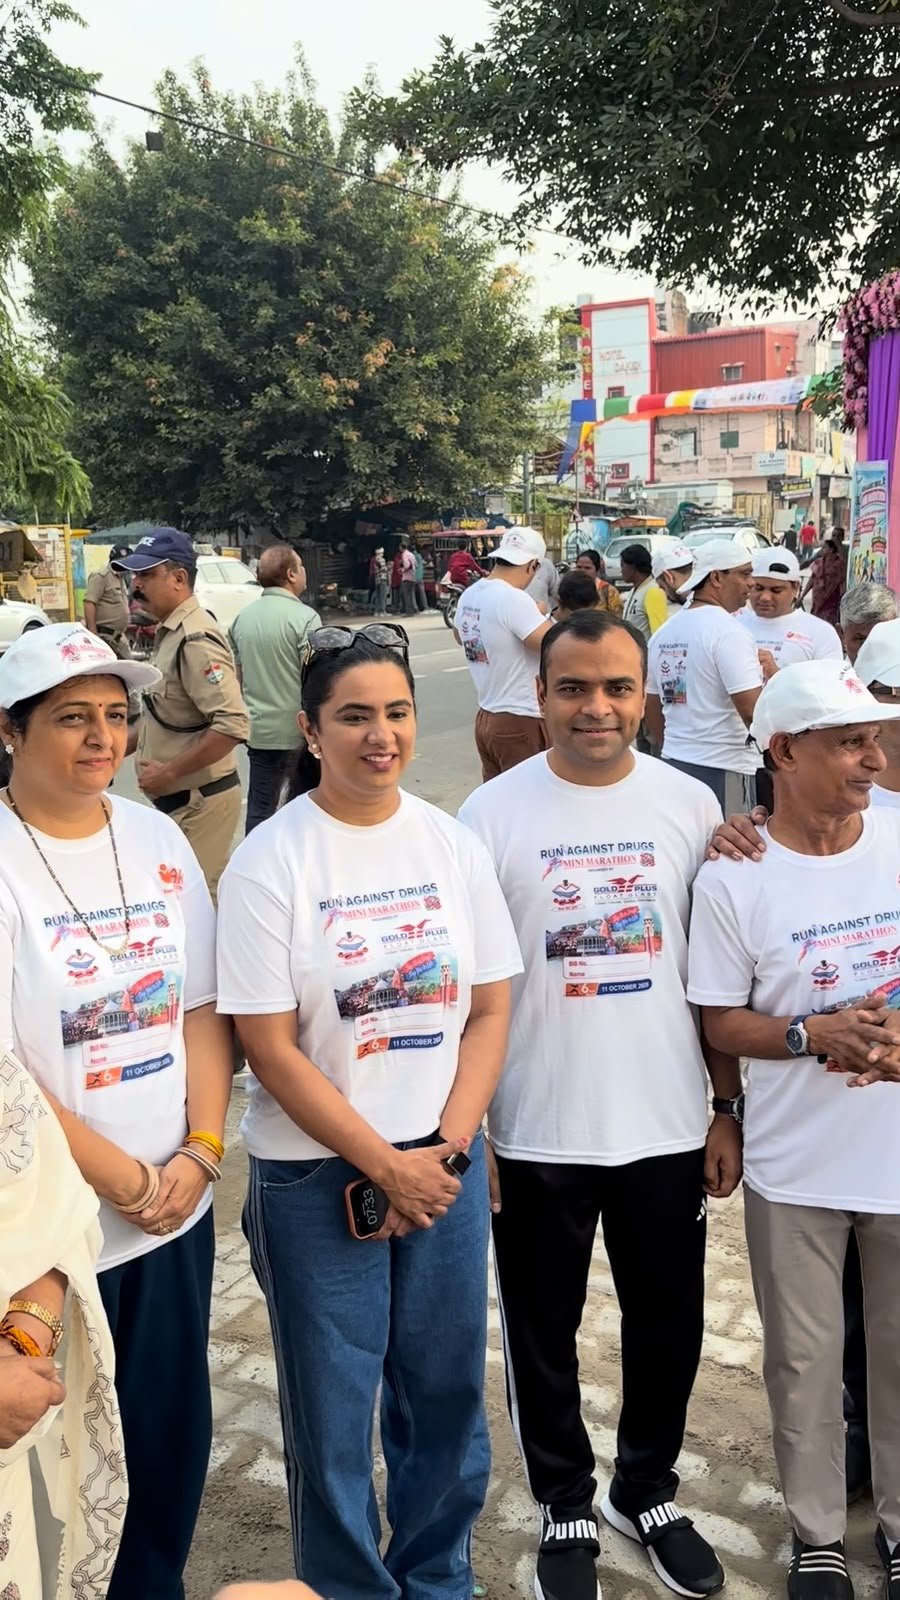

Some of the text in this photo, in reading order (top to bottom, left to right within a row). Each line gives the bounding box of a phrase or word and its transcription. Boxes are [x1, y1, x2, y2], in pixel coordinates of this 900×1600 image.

[540, 841, 655, 859] RUN AGAINST DRUGS
[563, 854, 637, 868] MINI MARATHON
[319, 882, 438, 912] RUN AGAINST DRUGS
[593, 884, 658, 894] GOLD PLUS
[44, 900, 166, 928] RUN AGAINST DRUGS
[343, 907, 368, 919] MINI
[368, 900, 421, 915] MARATHON
[381, 928, 449, 942] GOLD PLUS
[792, 928, 818, 943] RUN
[820, 916, 871, 935] AGAINST
[818, 936, 840, 948] MINI
[842, 924, 897, 942] MARATHON
[110, 945, 177, 961] GOLD PLUS
[852, 960, 880, 970] GOLD
[400, 1038, 433, 1046] OCTOBER
[126, 1069, 133, 1077] 11
[134, 1061, 161, 1075] OCTOBER
[363, 1188, 378, 1225] 07:33
